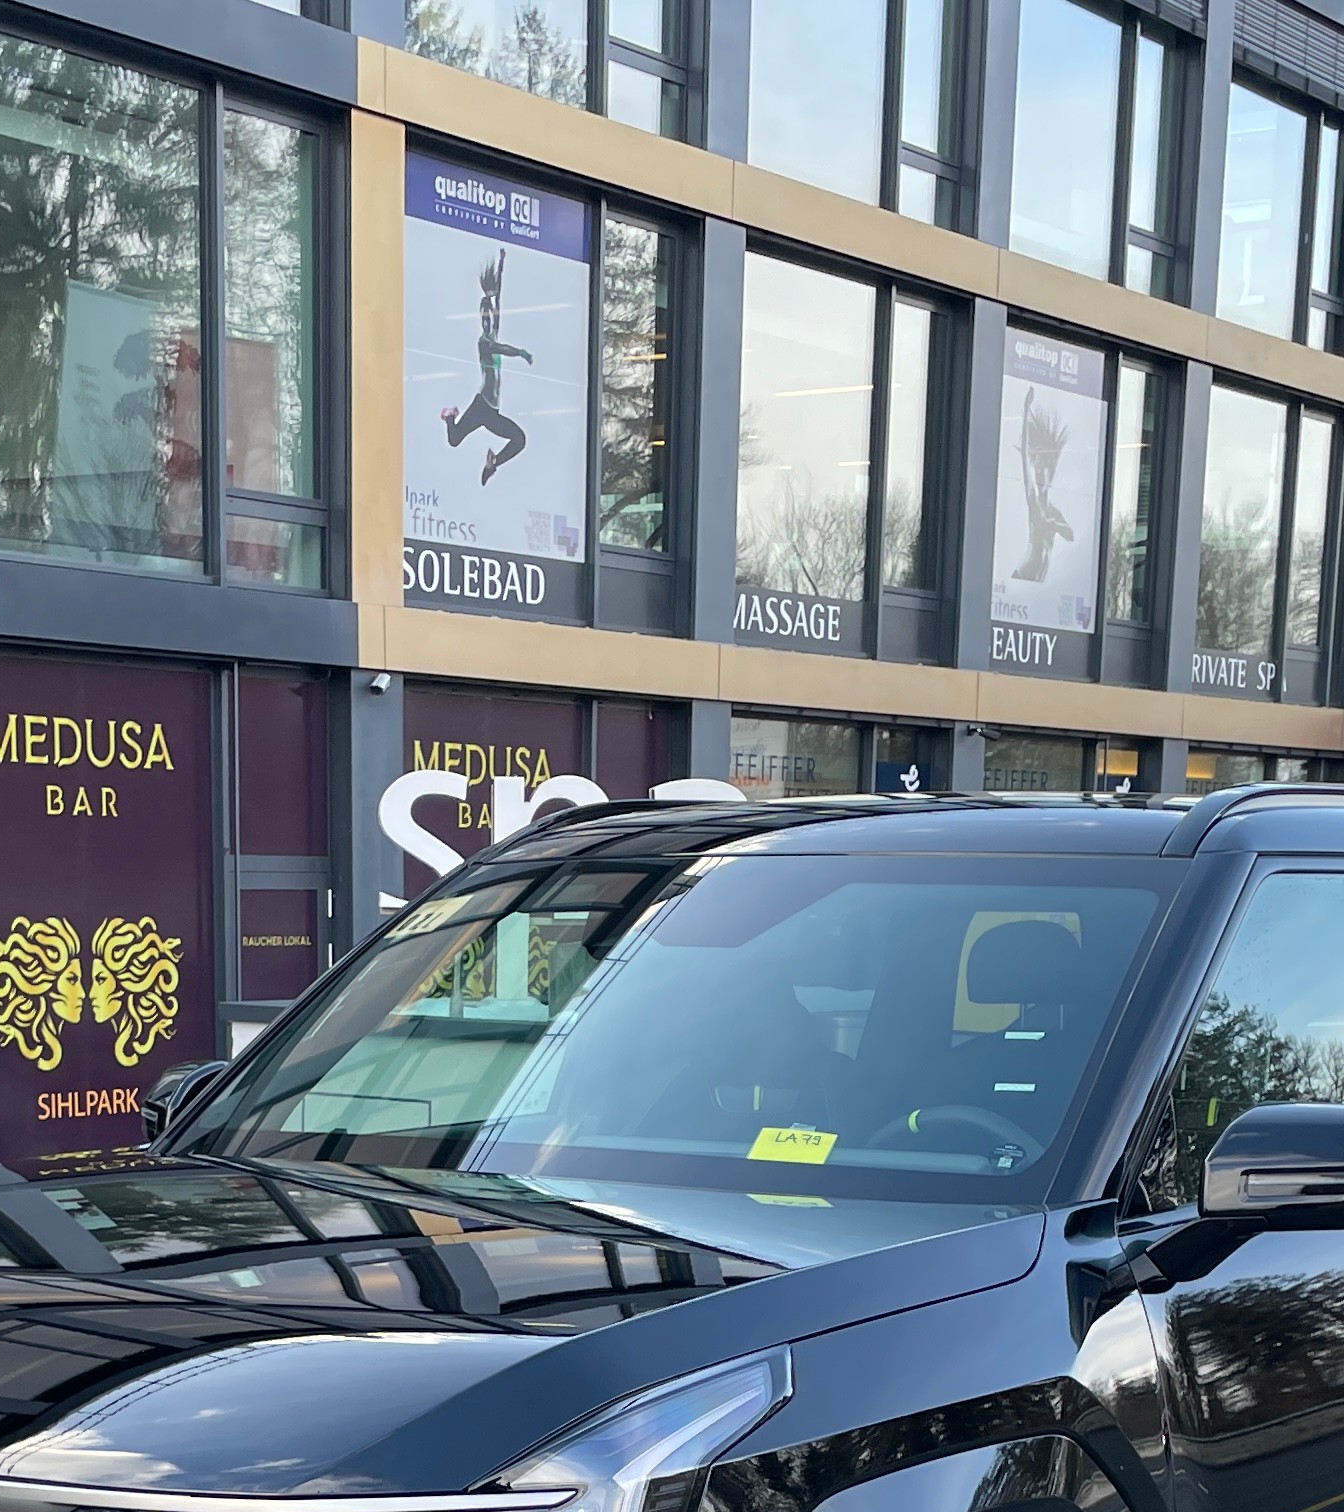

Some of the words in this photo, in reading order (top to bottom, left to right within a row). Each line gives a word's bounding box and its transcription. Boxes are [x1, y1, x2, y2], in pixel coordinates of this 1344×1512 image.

[434, 175, 506, 215] qualitop
[1015, 340, 1059, 369] qualitop
[412, 507, 477, 543] fitness
[403, 546, 546, 605] SOLEBAD
[988, 626, 1058, 666] EAUTY
[1191, 653, 1247, 689] RIVATE
[1256, 661, 1288, 693] SP
[413, 740, 552, 789] MEDUSA
[733, 752, 816, 784] FEIFFER
[45, 784, 119, 818] BAR
[459, 802, 494, 829] BA
[242, 935, 283, 947] RAUCHER
[283, 935, 312, 947] LOKAL
[37, 1087, 140, 1120] SIHLPARK
[775, 1131, 798, 1143] LA
